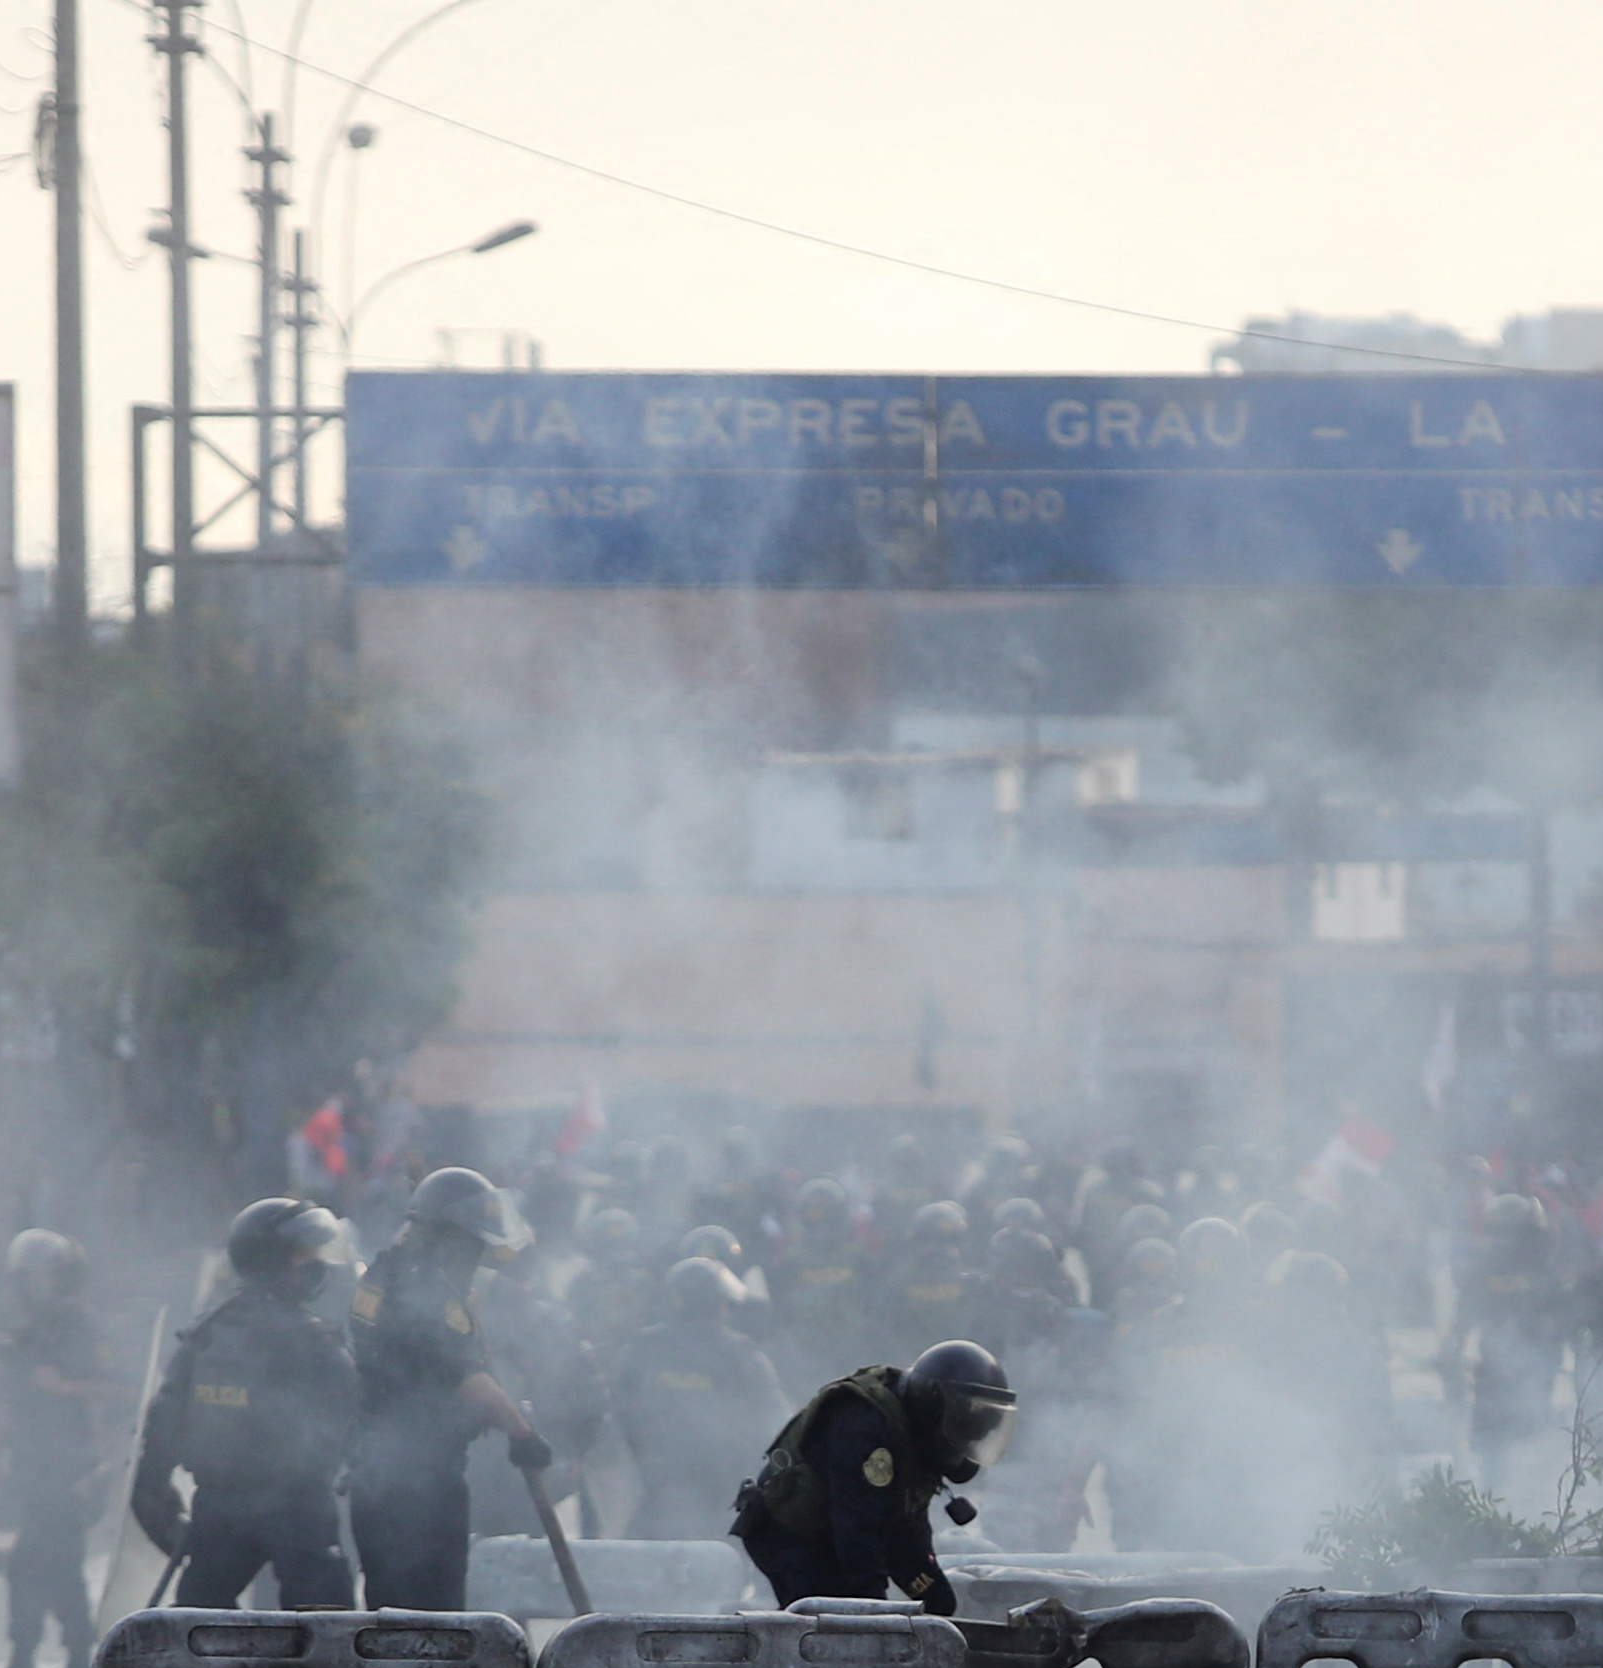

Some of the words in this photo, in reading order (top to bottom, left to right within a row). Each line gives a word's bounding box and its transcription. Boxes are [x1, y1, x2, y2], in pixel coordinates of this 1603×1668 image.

[466, 399, 586, 446] VIA
[644, 399, 986, 448] EXPRESA
[1046, 399, 1250, 448] GRAU
[1409, 400, 1508, 449] LA
[464, 484, 658, 520] TRANSP
[856, 485, 1067, 523] PRVADO
